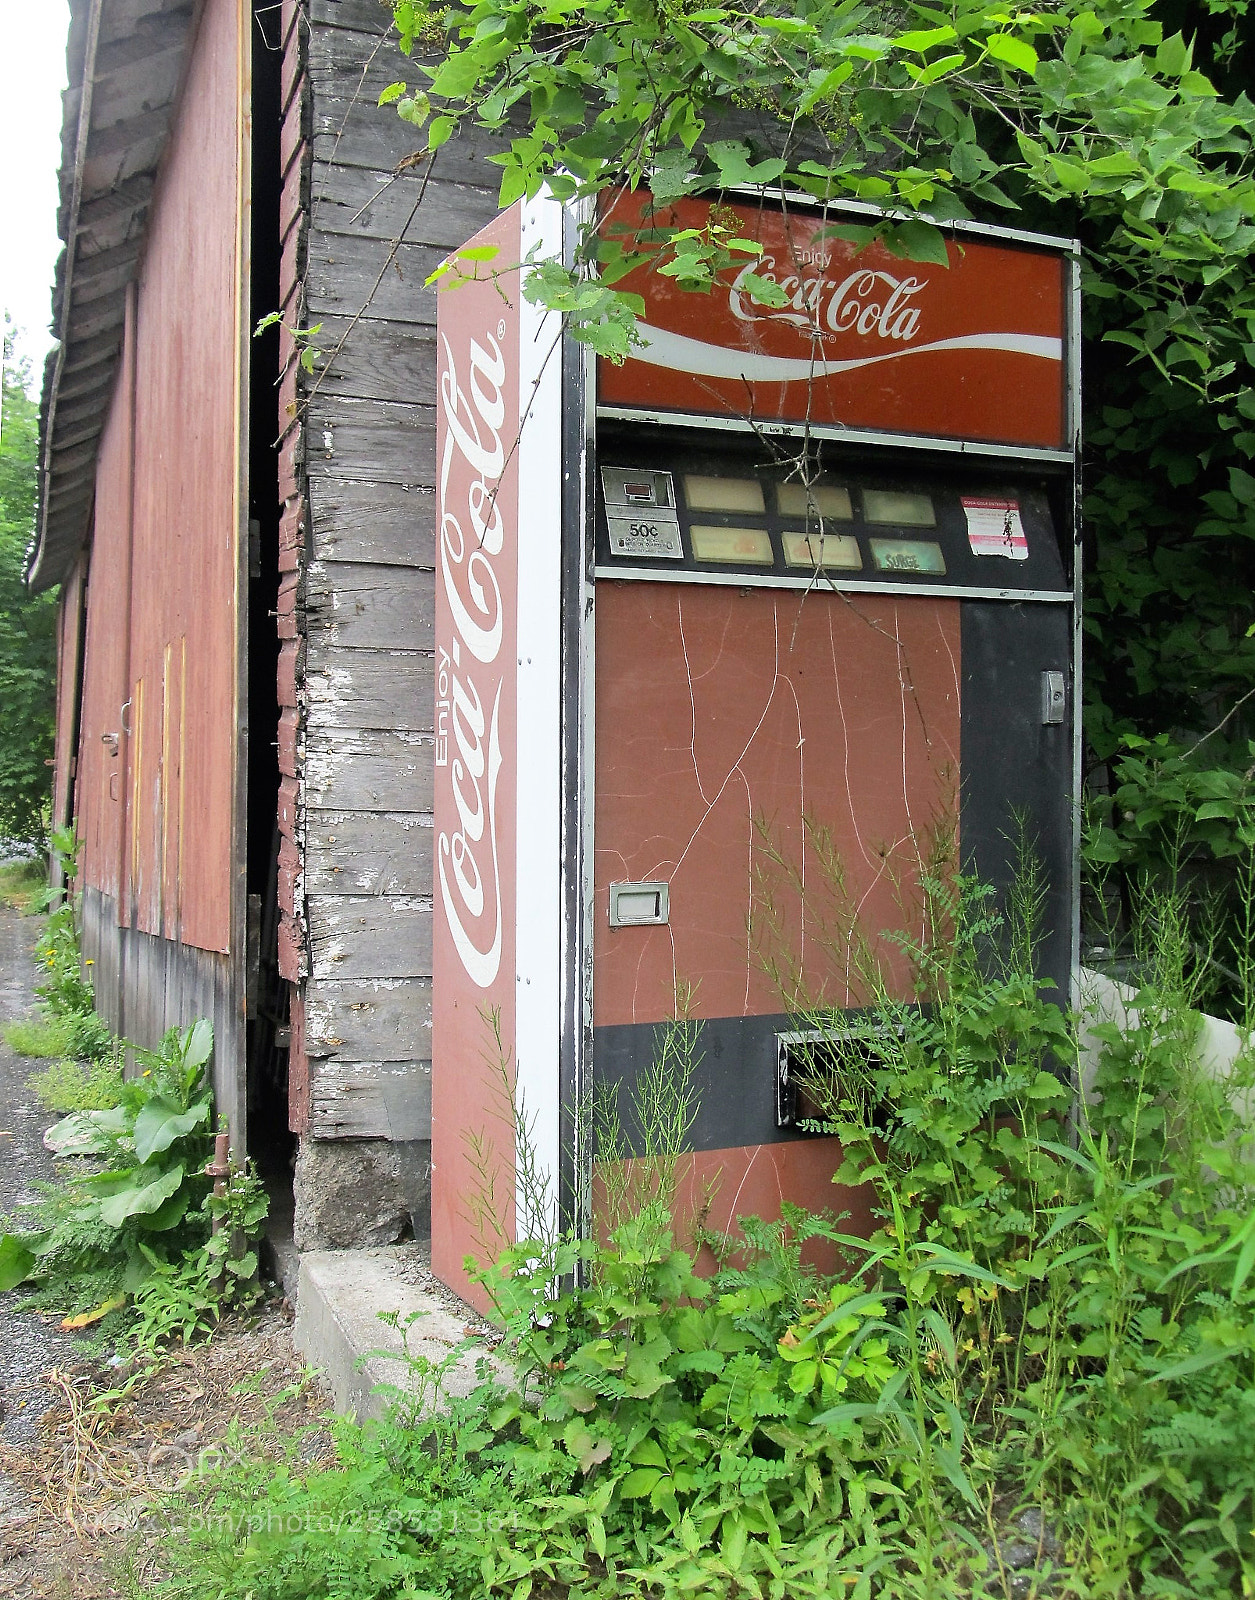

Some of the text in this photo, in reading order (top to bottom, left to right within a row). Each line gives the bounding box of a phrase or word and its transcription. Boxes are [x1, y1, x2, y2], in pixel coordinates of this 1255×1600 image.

[793, 245, 833, 269] Enjoy
[630, 523, 659, 539] 50¢
[885, 553, 920, 569] SURGE
[437, 331, 506, 989] Coca-Cola
[435, 645, 451, 767] Enjoy
